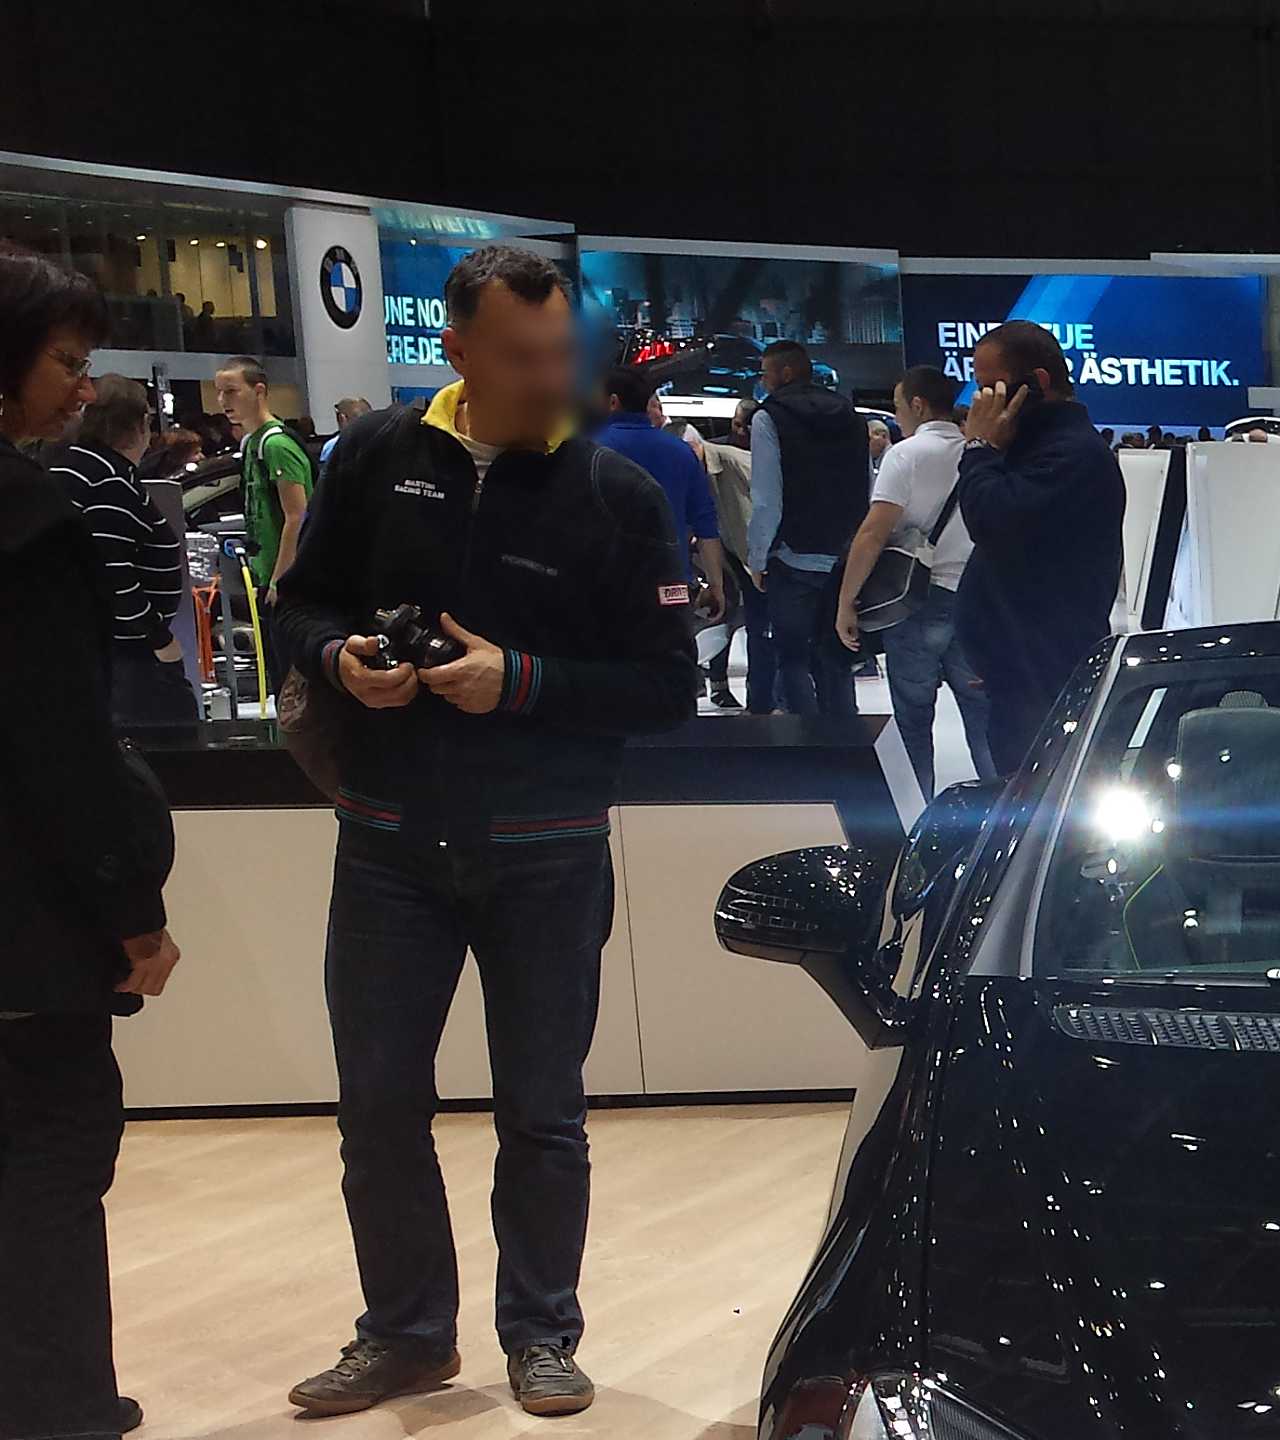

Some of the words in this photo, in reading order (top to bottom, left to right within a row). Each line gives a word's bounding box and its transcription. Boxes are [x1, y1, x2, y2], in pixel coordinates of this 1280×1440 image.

[416, 297, 447, 328] NO
[937, 322, 1003, 349] EIN
[1080, 351, 1240, 387] ÄSTHETIK.
[423, 489, 445, 499] TEAM
